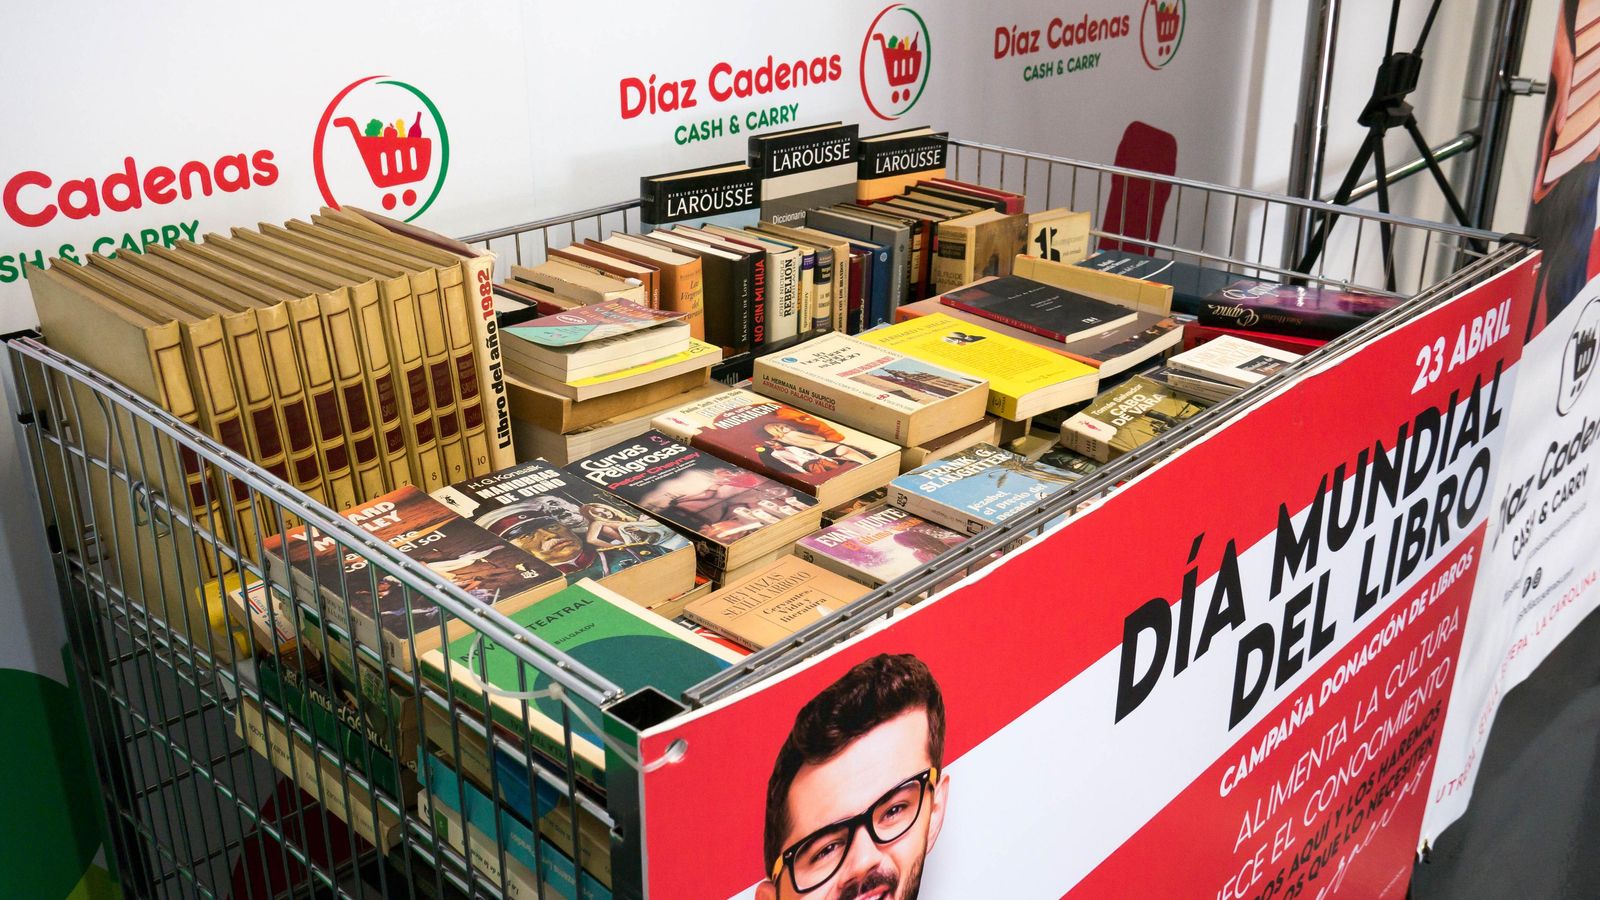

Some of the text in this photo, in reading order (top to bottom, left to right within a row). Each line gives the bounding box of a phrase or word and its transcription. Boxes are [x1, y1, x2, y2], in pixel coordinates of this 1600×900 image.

[994, 11, 1130, 60] Díaz Cadenas
[1023, 52, 1101, 83] CASH & CARRY
[620, 54, 842, 119] Díaz Cadenas
[674, 103, 799, 146] CASH & CARRY
[773, 142, 851, 172] LAROUSSE
[876, 150, 941, 174] LAROUSSE
[3, 149, 279, 228] Cadenas
[667, 188, 753, 217] LAROUSSE
[772, 210, 807, 225] Diccionario
[743, 299, 748, 310] DE
[754, 259, 765, 342] NO SIN MI HIJA
[1207, 302, 1260, 328] Caprice
[477, 268, 511, 450] Libro del año 1982
[1411, 298, 1512, 395] 23 ABRIL
[762, 380, 788, 394] ARMANDO
[790, 391, 814, 404] PALACIO
[770, 376, 797, 391] HERMANA
[798, 386, 810, 396] SAN
[812, 392, 836, 404] SULPICIO
[1109, 394, 1146, 416] CABO
[1112, 384, 1143, 402] Salvador
[714, 402, 782, 430] MUCHACHA
[1111, 394, 1168, 426] DE VARA
[455, 464, 460, 473] 9
[477, 456, 486, 466] 10
[580, 444, 649, 472] Curvas
[585, 444, 688, 486] Peligrosas
[919, 451, 1013, 492] SLAUGHTER
[920, 448, 996, 480] FRANK G.
[432, 472, 438, 481] 8
[475, 469, 561, 499] MANIOBRAS
[494, 478, 567, 505] DE OTOÑO
[984, 482, 1048, 516] el precio del
[1539, 502, 1548, 524] &
[1551, 464, 1589, 514] CARRY
[286, 520, 292, 528] 3
[418, 530, 448, 547] sol
[814, 528, 859, 548] EVAN
[854, 508, 908, 532] HUNTE
[1114, 358, 1504, 725] DÍA MUNDIAL
[722, 572, 785, 604] REY HAZAS
[724, 571, 812, 618] SEVILLA ARROYO
[1228, 447, 1490, 732] DEL LIBRO
[524, 599, 594, 631] TEATRAL
[780, 598, 828, 622] literatura
[554, 622, 596, 645] BULGAKOV
[1220, 697, 1314, 797] CAMPAÑA
[1320, 613, 1406, 708] DONACIÓN
[1408, 592, 1428, 630] DE
[1428, 546, 1474, 612] LIBROS
[1233, 604, 1460, 854] ALIMENTA LA CULTURA
[1271, 817, 1296, 864] EL
[1304, 655, 1451, 828] CONOCIMIENTO
[1288, 812, 1329, 880] AQUÍ
[1335, 804, 1345, 828] Y
[1346, 773, 1376, 816] LOS
[1376, 699, 1442, 784] HAREMOS
[1308, 835, 1340, 881] QUE
[1343, 812, 1364, 844] LO
[1364, 729, 1437, 822] NECESITEN
